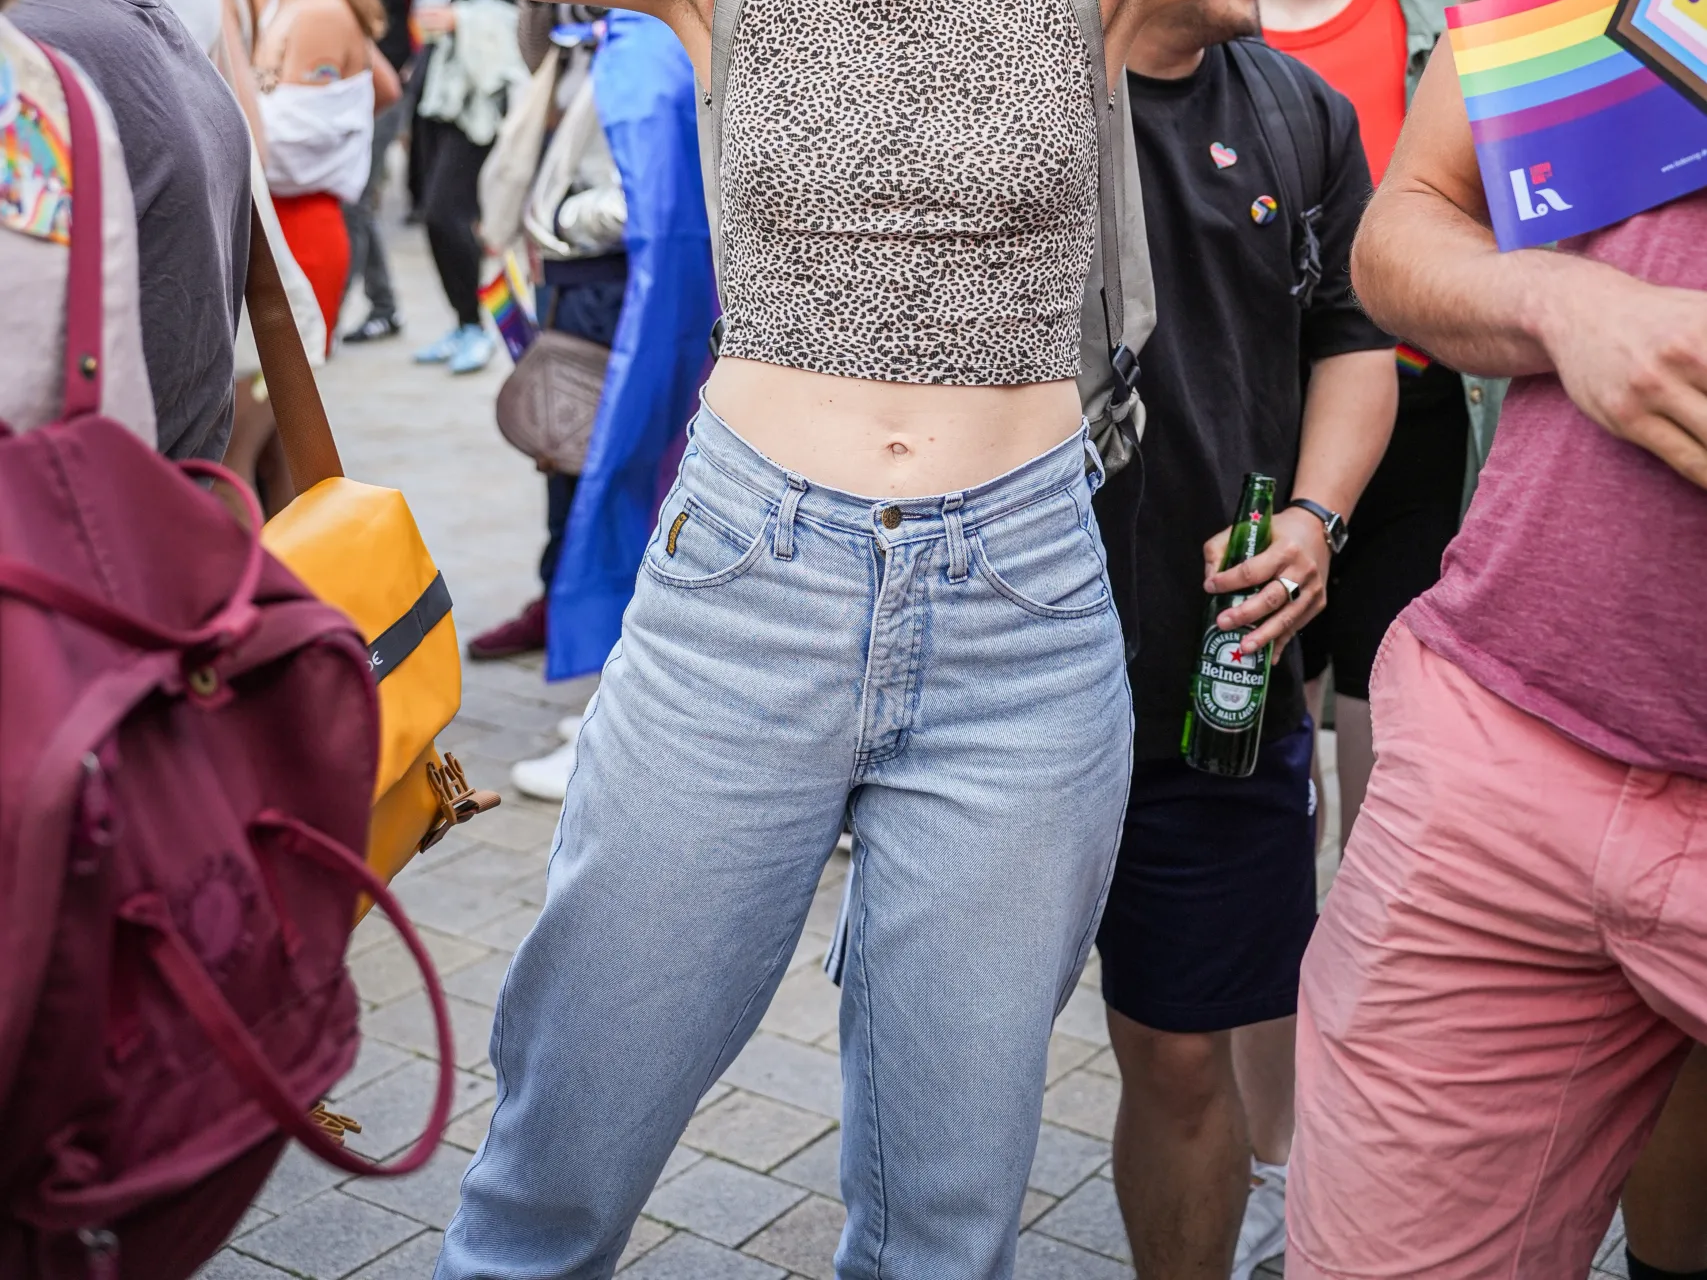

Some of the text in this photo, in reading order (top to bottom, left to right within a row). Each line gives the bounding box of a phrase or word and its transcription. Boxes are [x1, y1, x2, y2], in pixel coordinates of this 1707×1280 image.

[1201, 660, 1264, 686] Heineken
[1203, 692, 1257, 721] PURE MALT LAGER
